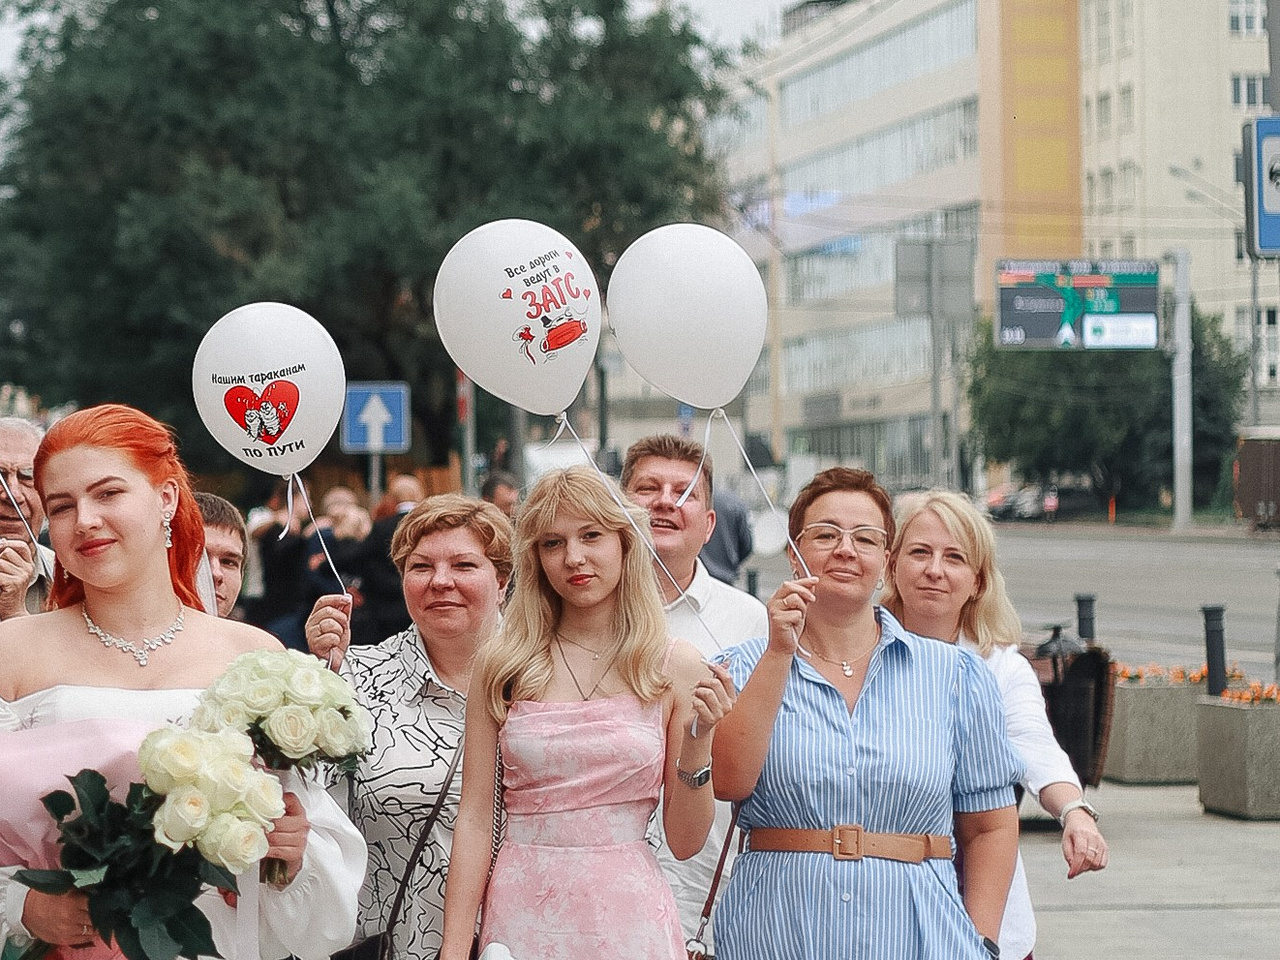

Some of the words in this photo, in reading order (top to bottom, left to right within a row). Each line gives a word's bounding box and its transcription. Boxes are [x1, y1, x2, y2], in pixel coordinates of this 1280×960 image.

[504, 265, 527, 278] Все
[529, 250, 560, 269] дороги
[523, 268, 552, 287] ведут
[552, 265, 560, 273] в
[522, 272, 580, 319] ЗАГС
[211, 373, 246, 384] Нашим
[248, 363, 306, 384] тараканам
